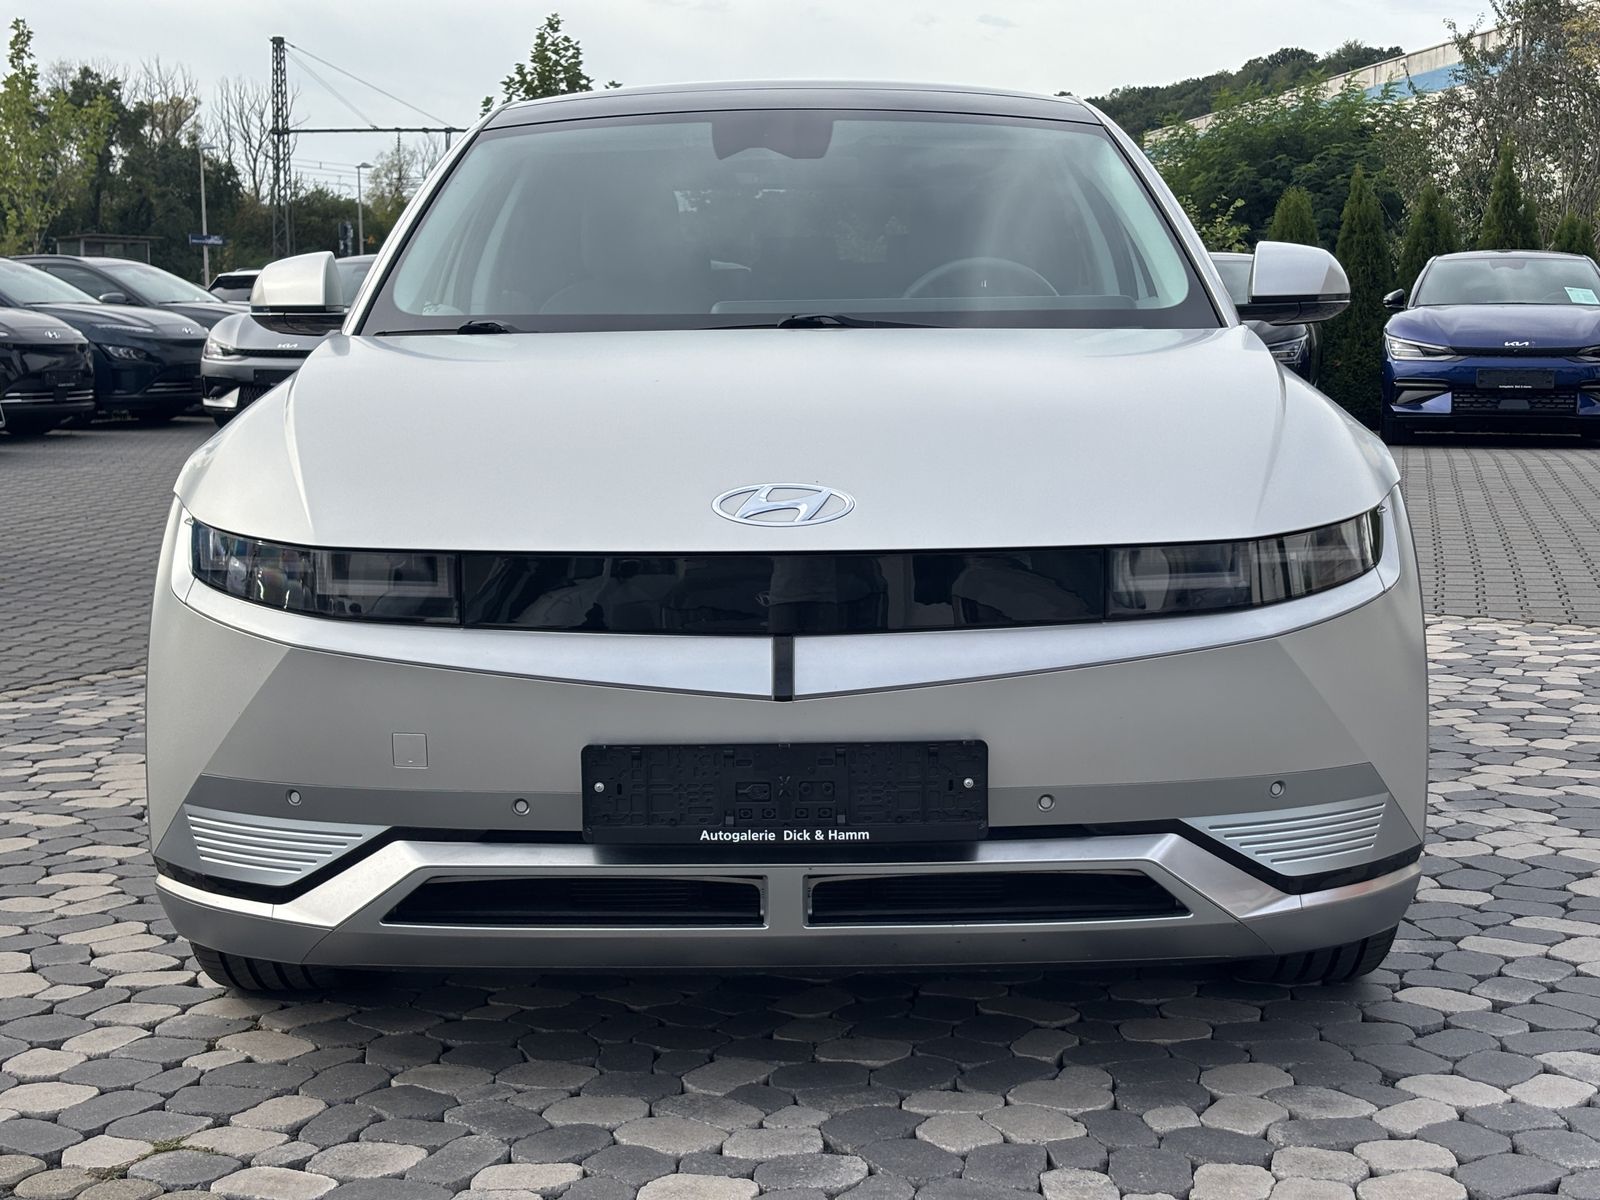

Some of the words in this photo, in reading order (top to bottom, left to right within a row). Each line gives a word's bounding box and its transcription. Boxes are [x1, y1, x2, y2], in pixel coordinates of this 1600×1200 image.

[700, 830, 776, 842] Autogalerie
[783, 829, 811, 841] Dick
[814, 829, 825, 841] &
[828, 829, 870, 840] Hamm
